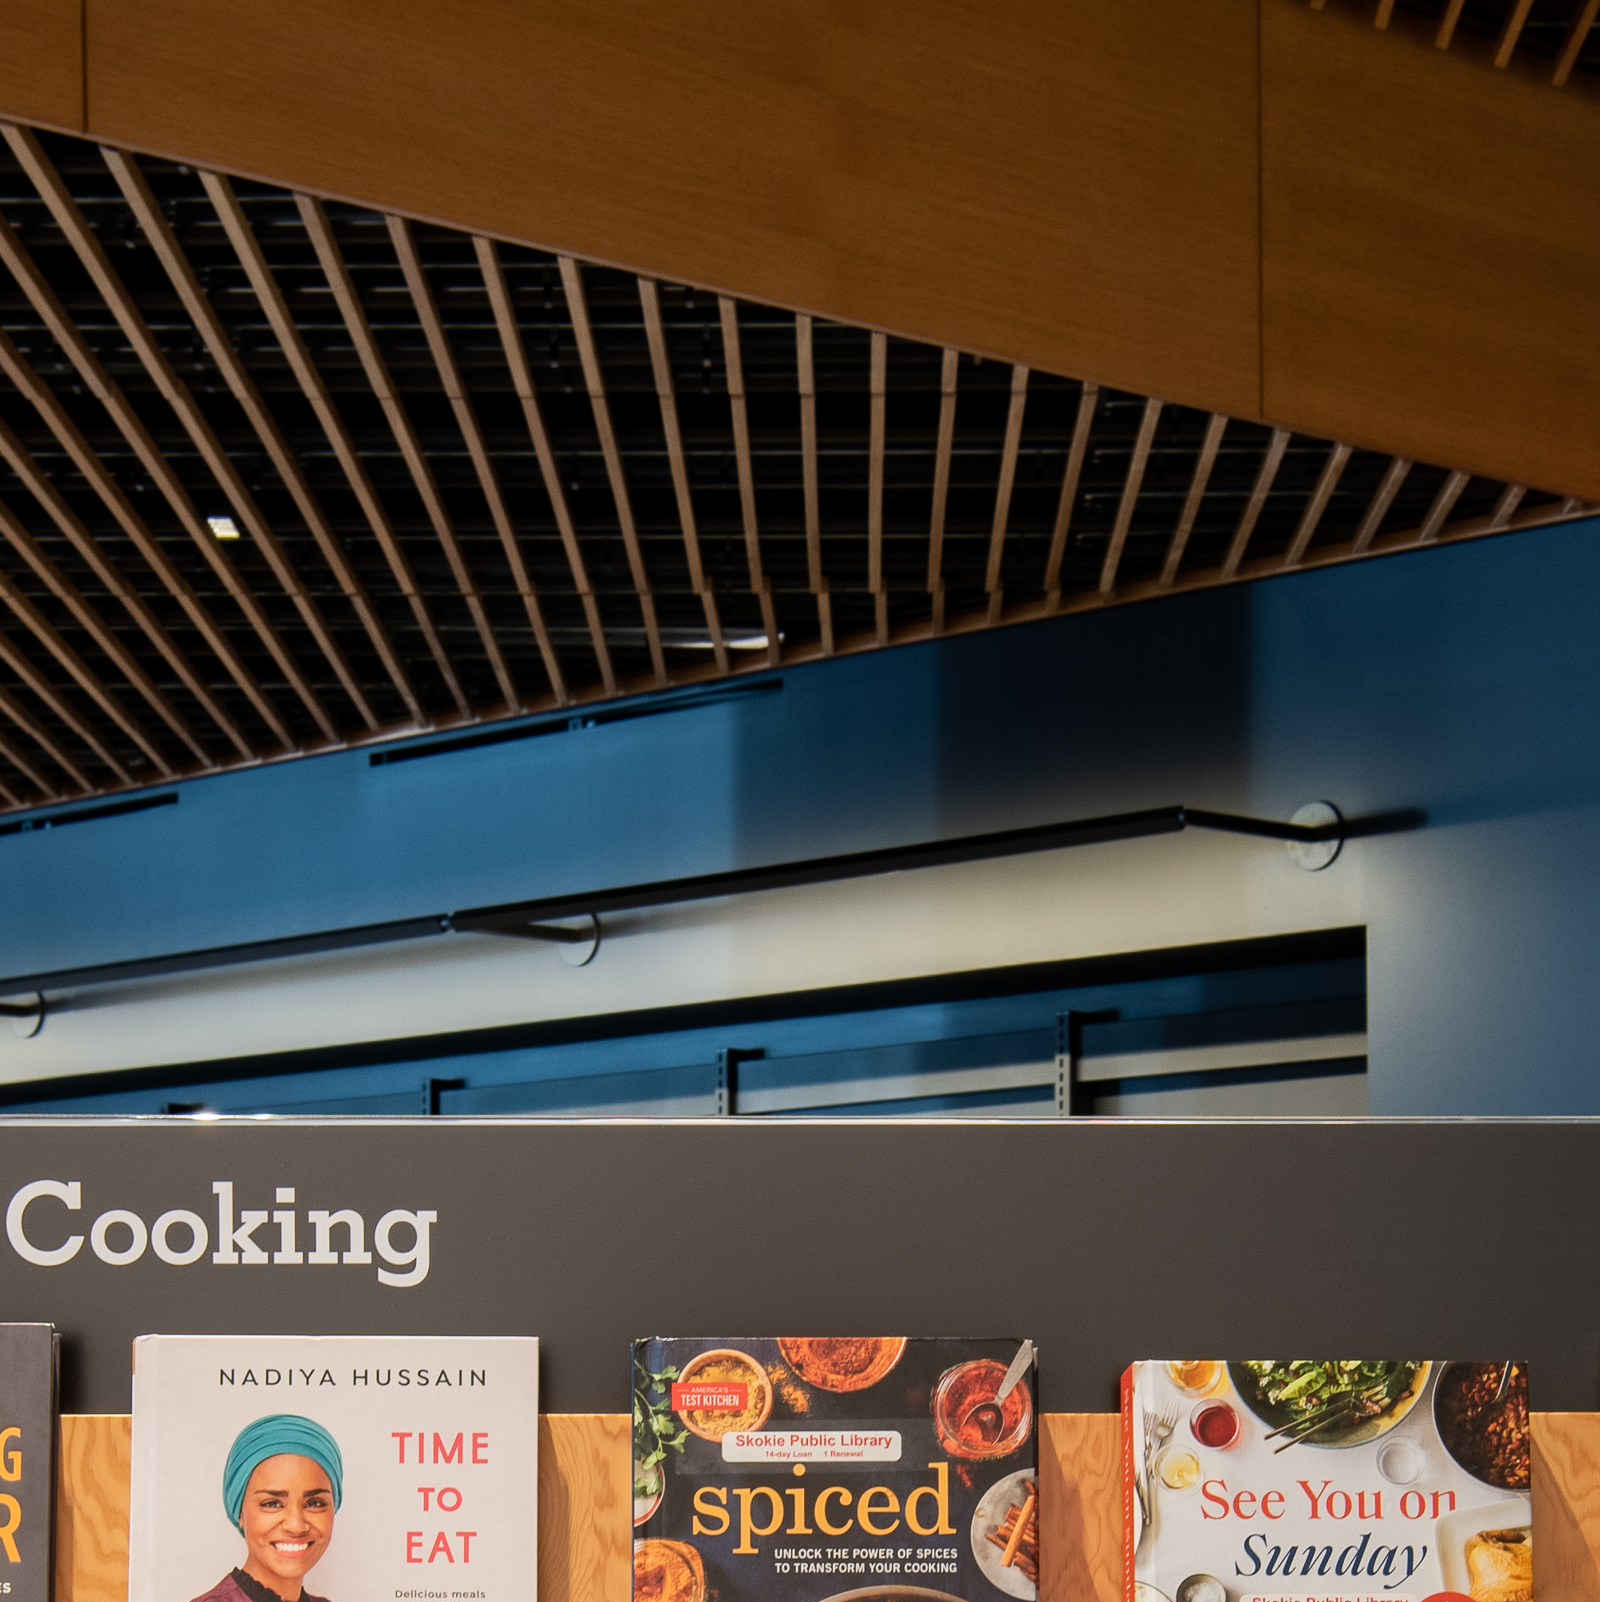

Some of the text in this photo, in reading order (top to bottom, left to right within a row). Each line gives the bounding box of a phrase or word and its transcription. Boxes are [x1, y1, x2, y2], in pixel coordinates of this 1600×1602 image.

[5, 1179, 438, 1287] Cooking
[218, 1367, 488, 1386] NADIYA HUSSAIN
[681, 1394, 739, 1406] TEST KITCHEN
[391, 1431, 490, 1464] TIME
[735, 1434, 892, 1449] Skokie Public Library
[417, 1486, 463, 1512] TO
[692, 1462, 956, 1554] spiced
[1199, 1479, 1456, 1521] See You on
[405, 1531, 478, 1563] EAT
[774, 1548, 958, 1560] UNLOCK THE POWER OF SPICES
[775, 1562, 958, 1574] TO TRANSFORM YOUR COOKING
[1234, 1532, 1428, 1590] Sunday
[395, 1589, 486, 1599] Delicious meals
